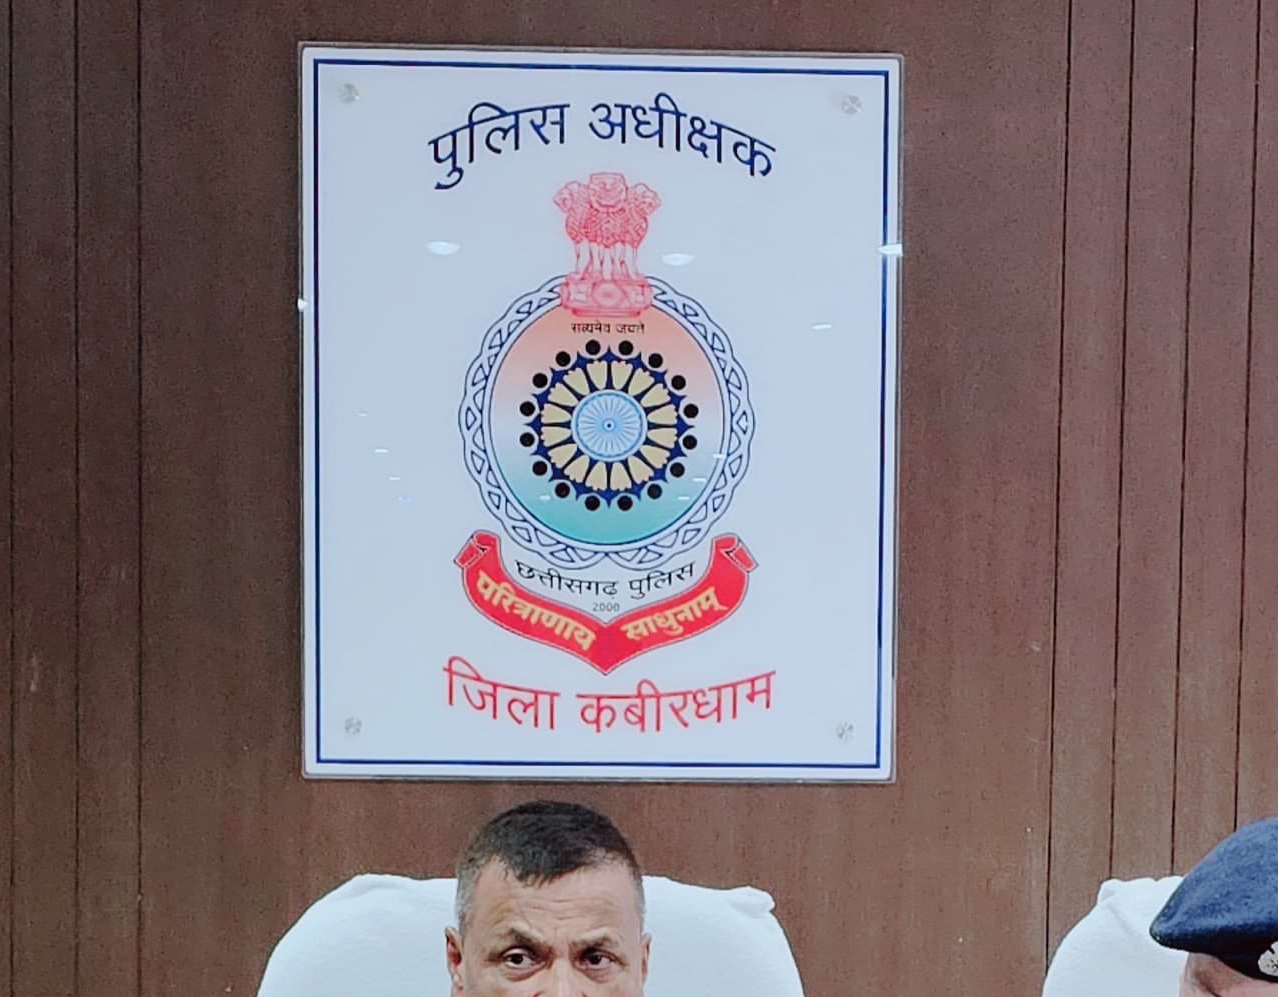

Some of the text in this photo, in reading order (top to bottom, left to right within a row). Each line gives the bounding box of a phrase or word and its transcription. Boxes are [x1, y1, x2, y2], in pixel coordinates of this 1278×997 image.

[427, 92, 777, 190] पुलिस अधीक्षक
[476, 570, 596, 650] परित्राणाय
[515, 560, 696, 599] छत्तीसगढ़ पुलिस
[592, 602, 620, 612] 2000
[442, 656, 777, 733] जिला कबीरधाम
